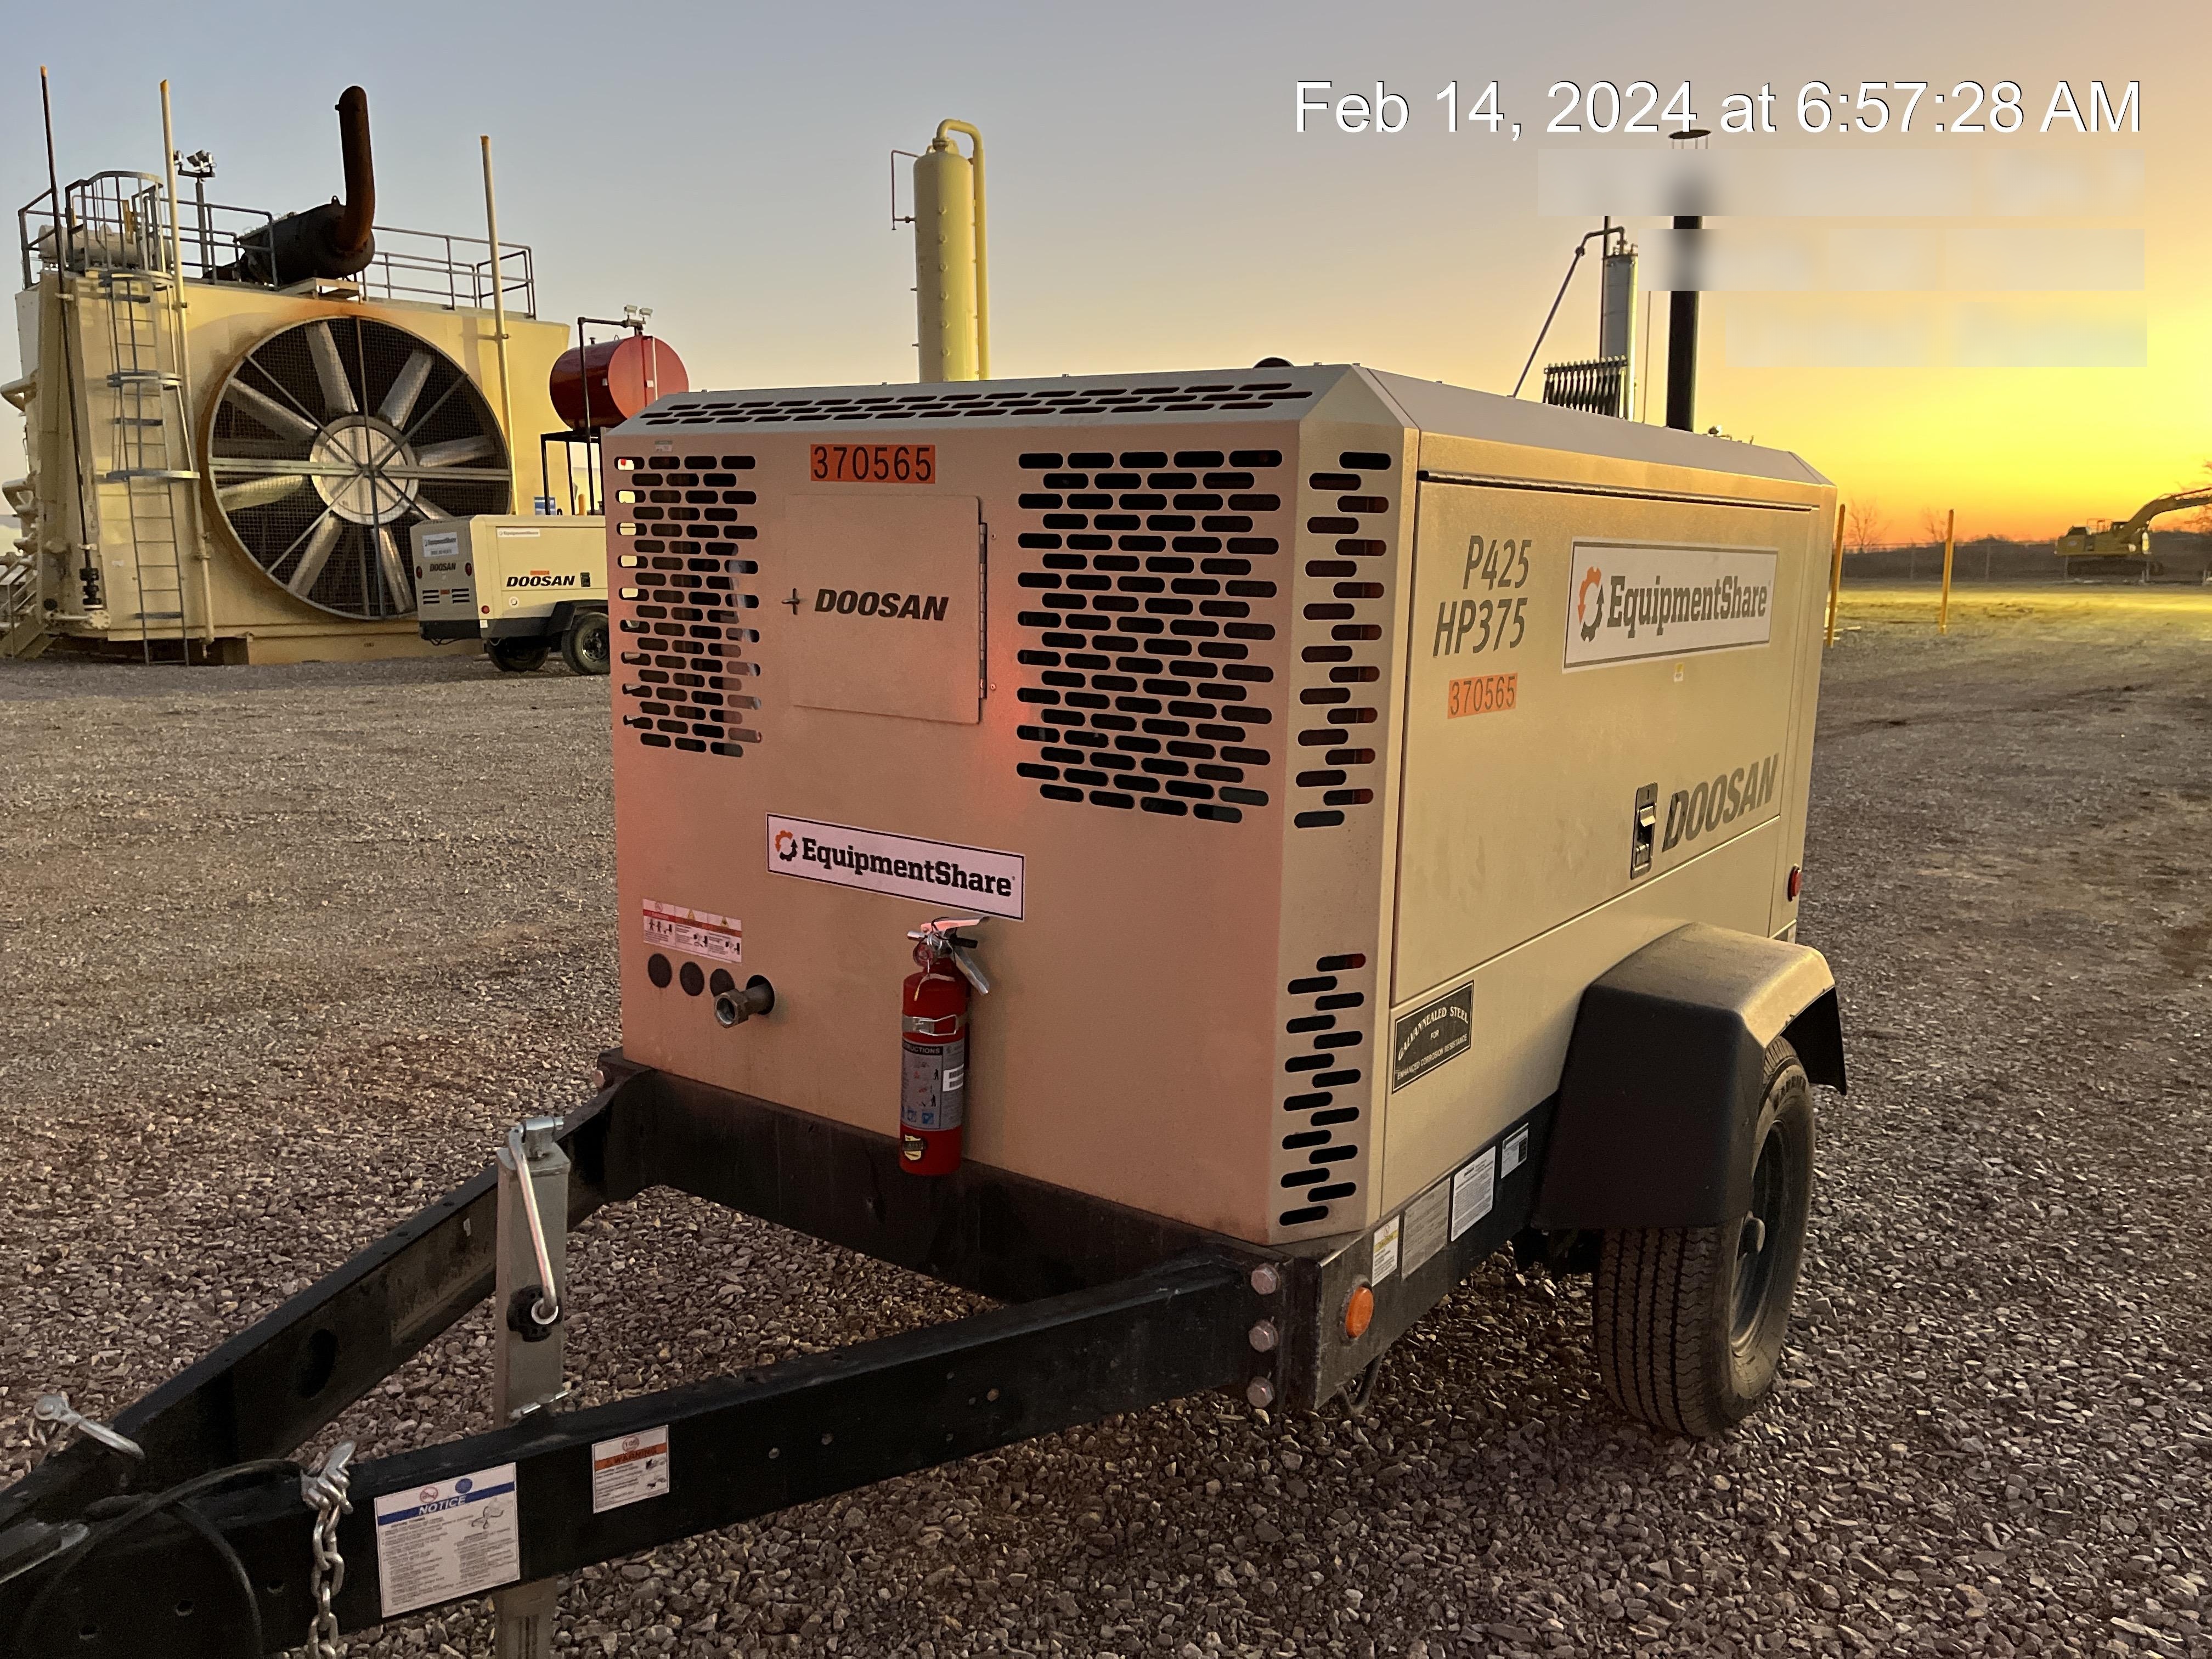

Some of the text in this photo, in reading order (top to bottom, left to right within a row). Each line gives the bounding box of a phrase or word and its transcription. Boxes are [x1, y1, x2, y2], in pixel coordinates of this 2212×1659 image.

[813, 446, 932, 482] 370565
[430, 562, 456, 572] DOOSAN
[1462, 535, 1532, 591] P425
[506, 575, 576, 587] DOOSAN
[814, 588, 950, 621] DOOSAN
[1606, 575, 1769, 639] EquipmentShare
[1432, 597, 1529, 658] HP375
[1449, 675, 1516, 715] 370565
[1661, 752, 1780, 853] DOOSAN
[801, 836, 1013, 898] EquipmentShare
[1449, 1006, 1469, 1025] STEEL
[1430, 1029, 1440, 1041] FOR
[614, 1446, 657, 1464] WARNING
[418, 1495, 467, 1515] NOTICE
